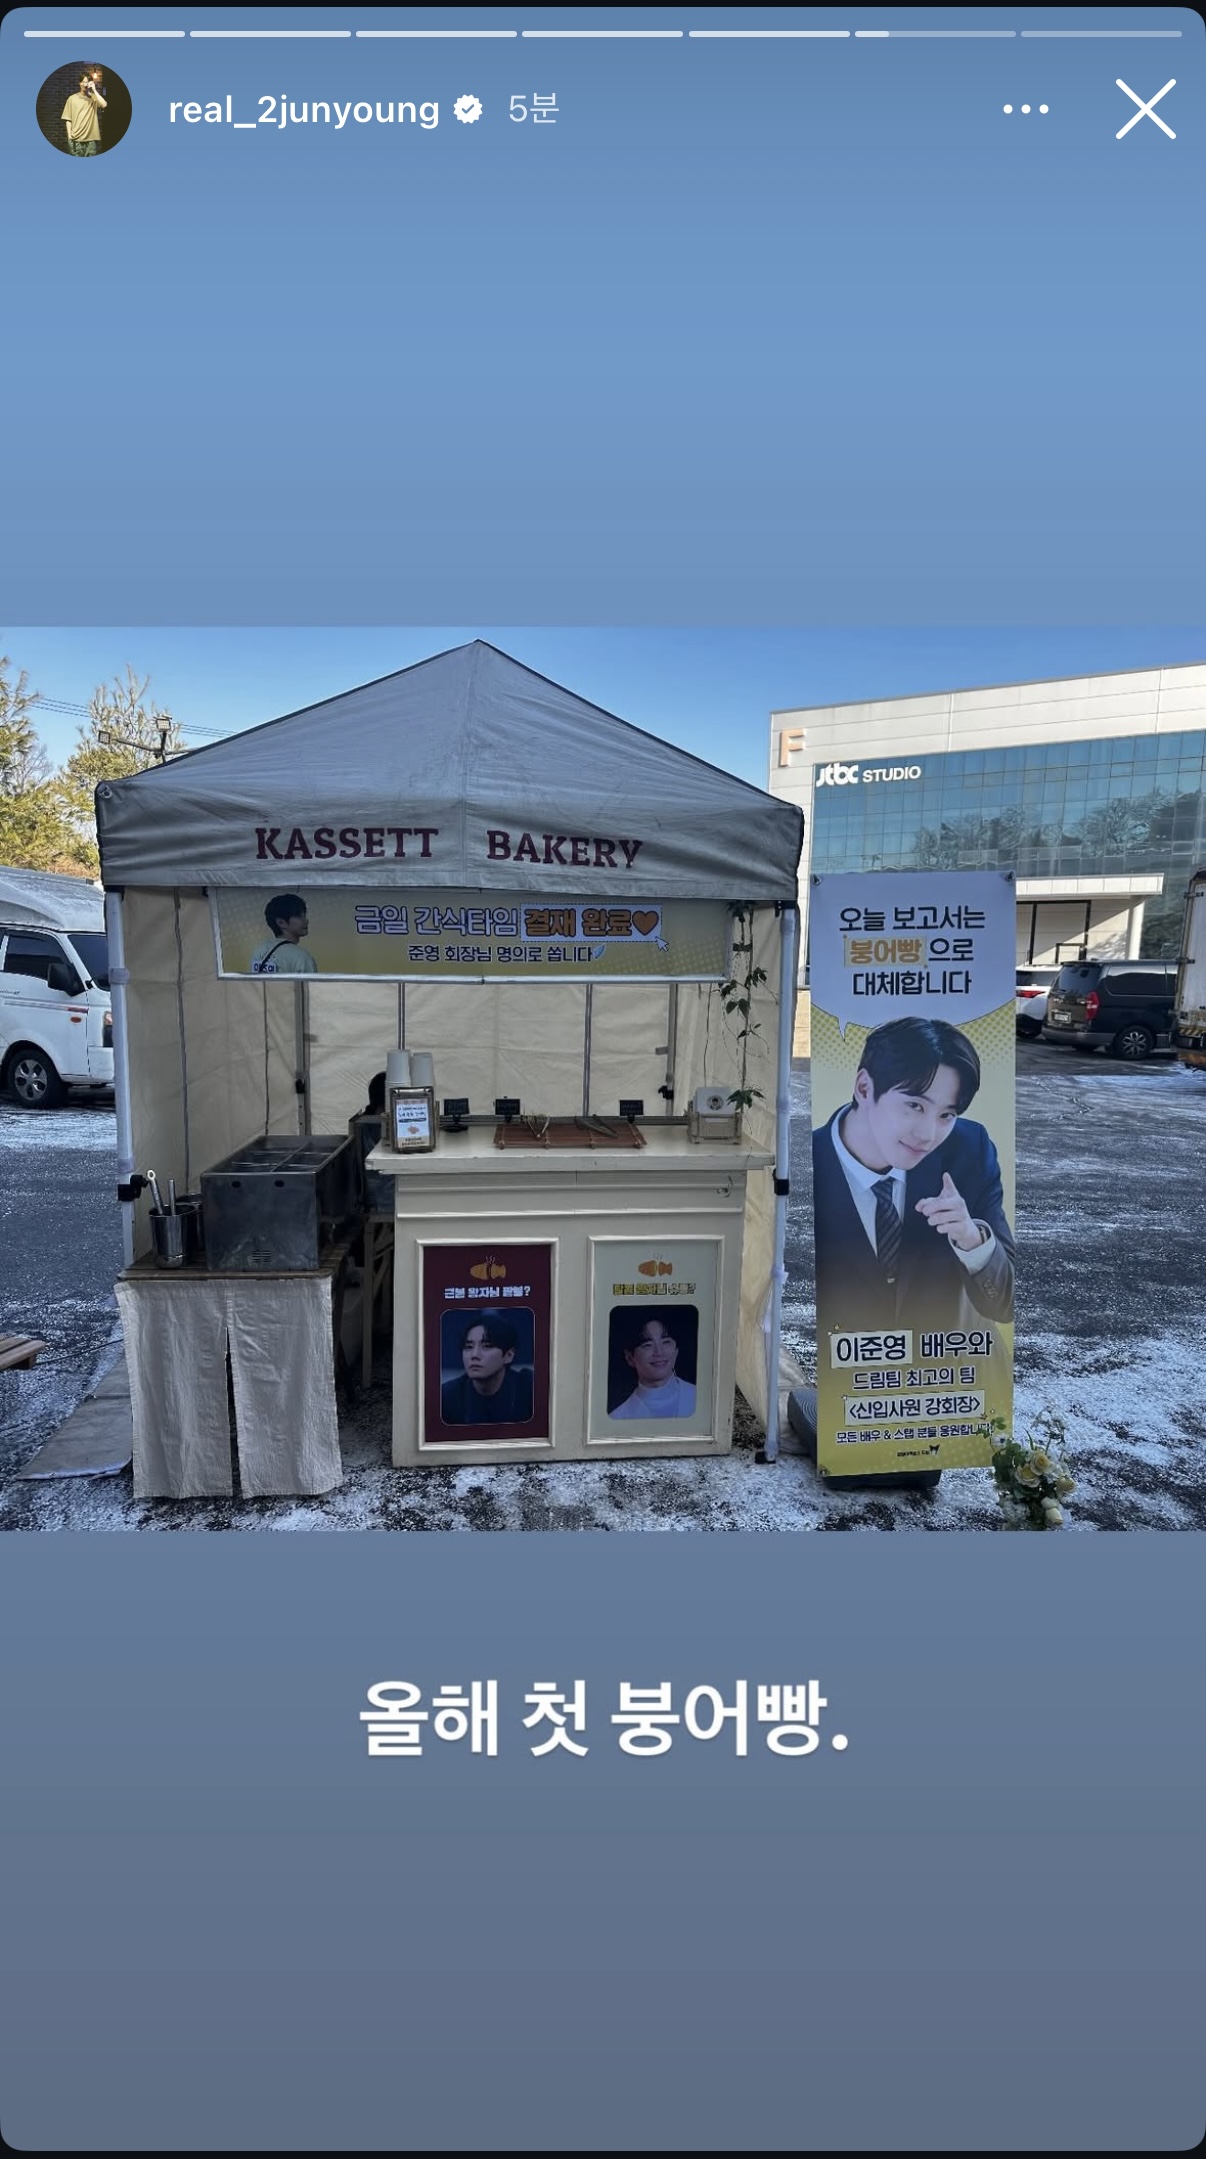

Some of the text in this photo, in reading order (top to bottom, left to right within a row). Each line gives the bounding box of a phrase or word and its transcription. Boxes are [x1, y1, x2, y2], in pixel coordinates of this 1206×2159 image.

[779, 728, 805, 767] F
[816, 763, 921, 787] jtbc STUDIO
[255, 827, 643, 869] KASSETT BAKERY
[355, 905, 632, 937] 금일 간식타임 결재 완료
[839, 905, 985, 931] 오늘 보고서는
[408, 945, 592, 963] 준영 회장님 명의로 쏩니다
[851, 938, 974, 964] 붕어빵 으로
[853, 970, 972, 996] 대체합니다
[468, 1286, 500, 1298] 왕자님
[837, 1331, 994, 1361] 이준영 배우와
[853, 1367, 975, 1390] 드림팀 최고의 팀
[849, 1396, 981, 1420] <신입사원 강회장>
[837, 1432, 857, 1443] 모든
[860, 1429, 881, 1442] 배우
[883, 1429, 892, 1440] &
[917, 1426, 937, 1438] 분들
